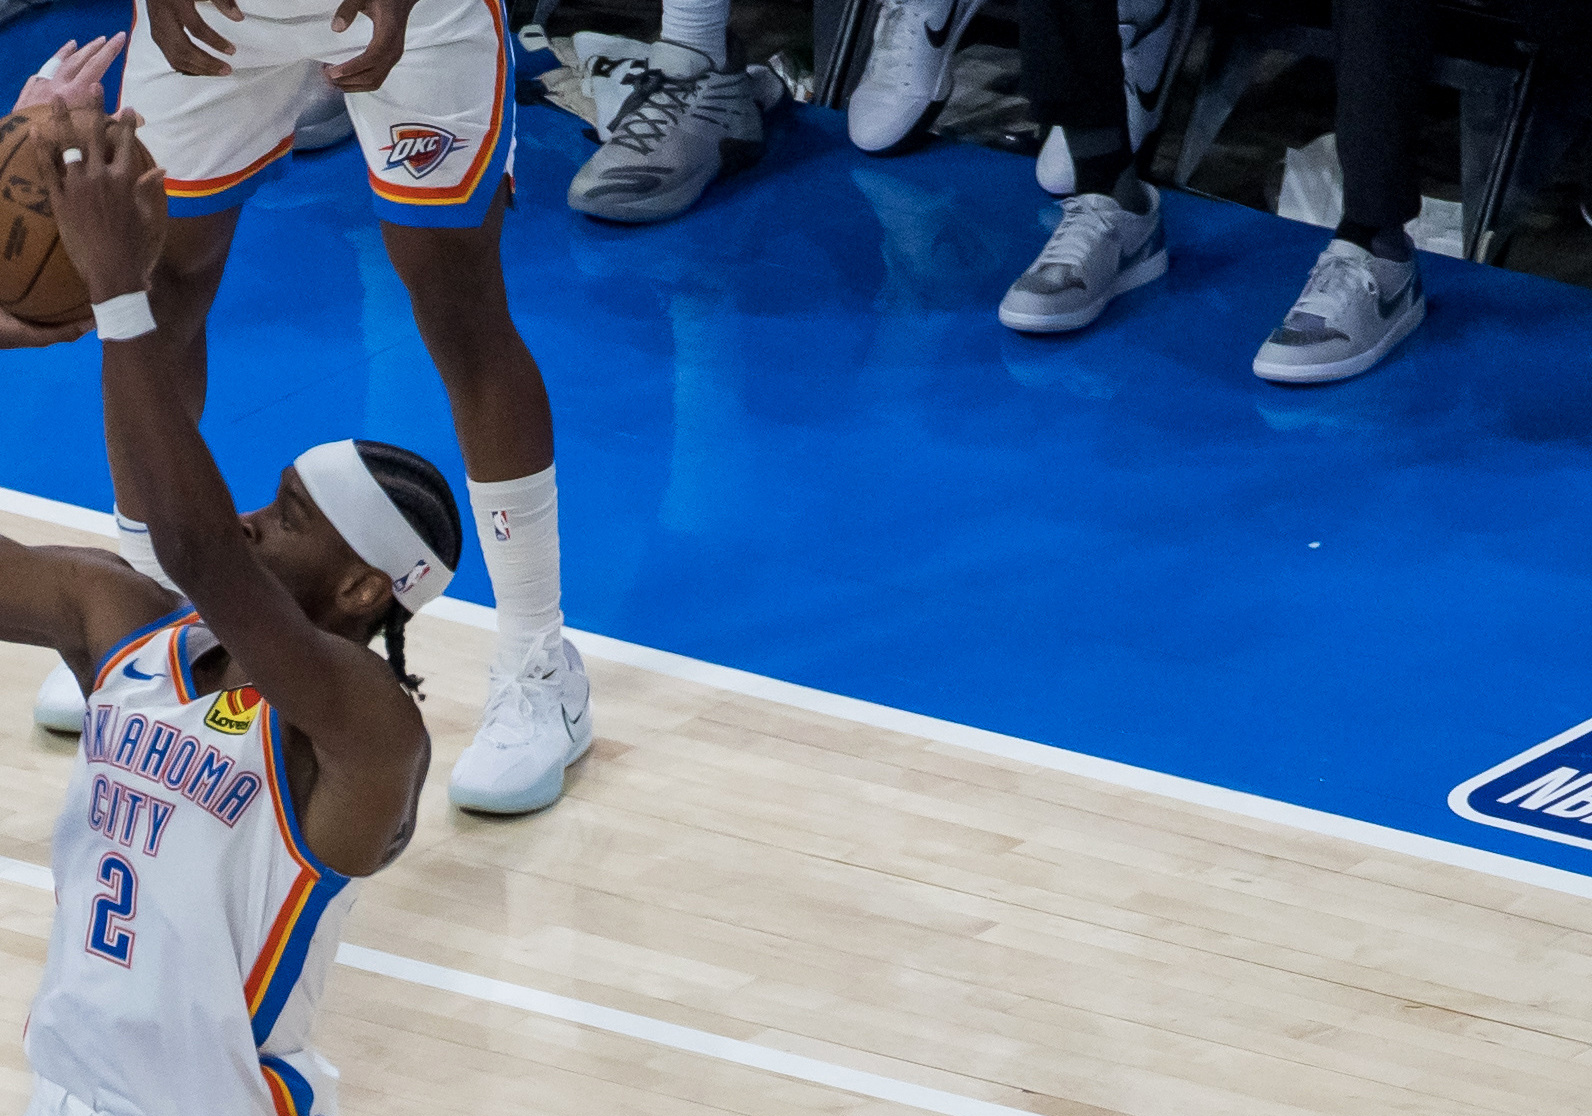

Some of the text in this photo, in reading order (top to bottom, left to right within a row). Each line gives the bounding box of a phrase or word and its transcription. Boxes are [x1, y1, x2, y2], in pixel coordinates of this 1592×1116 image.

[388, 136, 441, 164] OKC
[82, 705, 260, 828] OKAHOMA
[89, 773, 175, 857] CITY
[85, 851, 139, 969] 2
